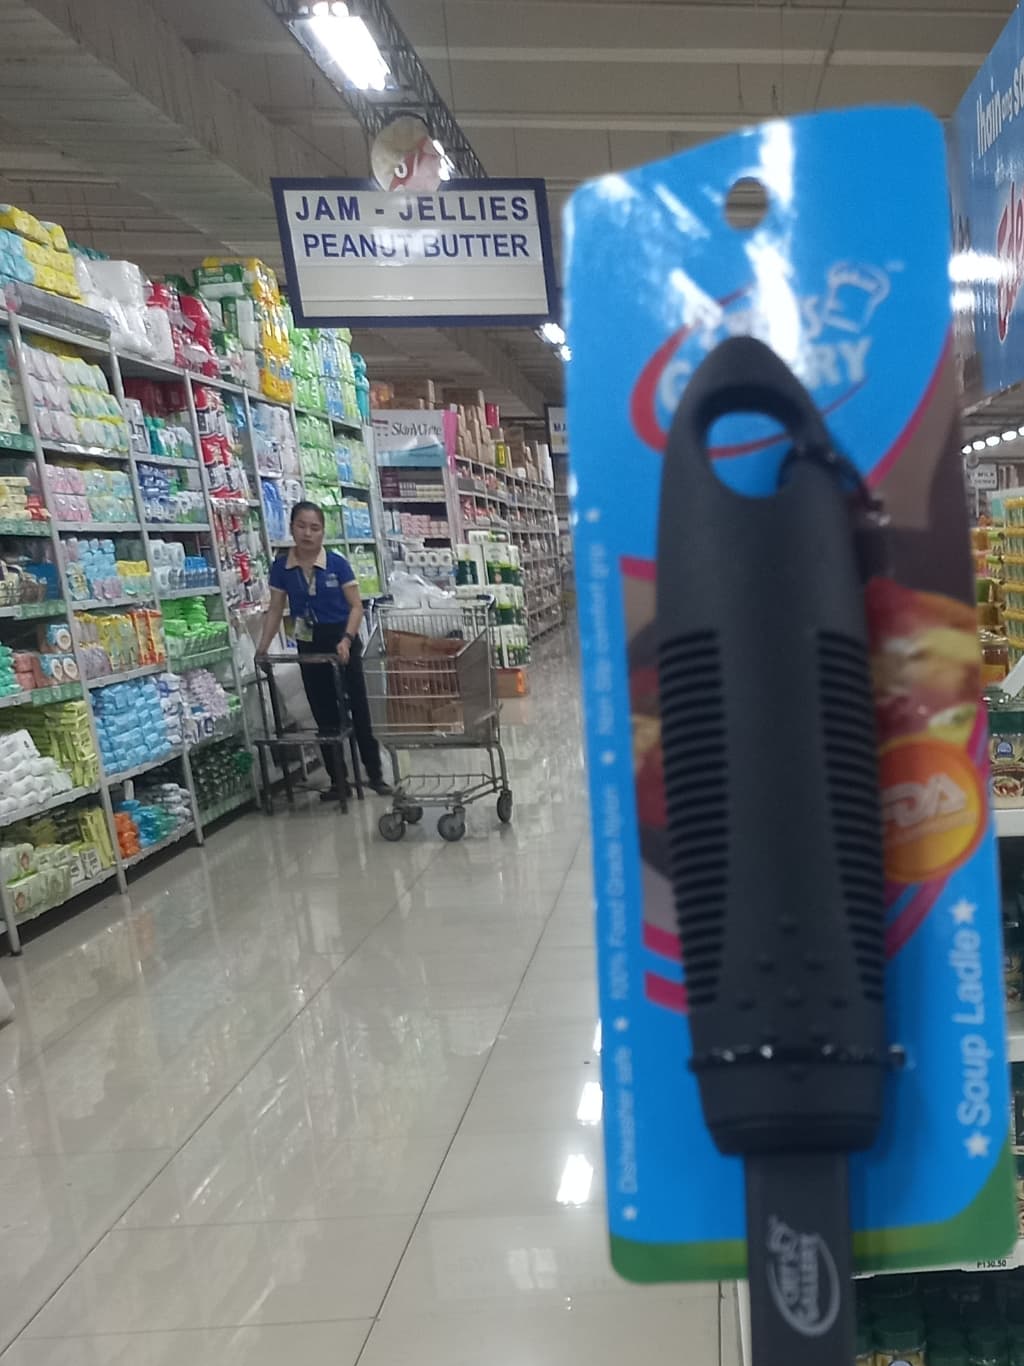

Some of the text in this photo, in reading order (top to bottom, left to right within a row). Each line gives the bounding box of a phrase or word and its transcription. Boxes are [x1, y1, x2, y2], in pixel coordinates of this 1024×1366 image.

[295, 196, 361, 221] JAM
[399, 196, 530, 221] JELLIES
[302, 233, 530, 258] PEANUT BUTTER
[948, 928, 995, 1126] Soup Ladle
